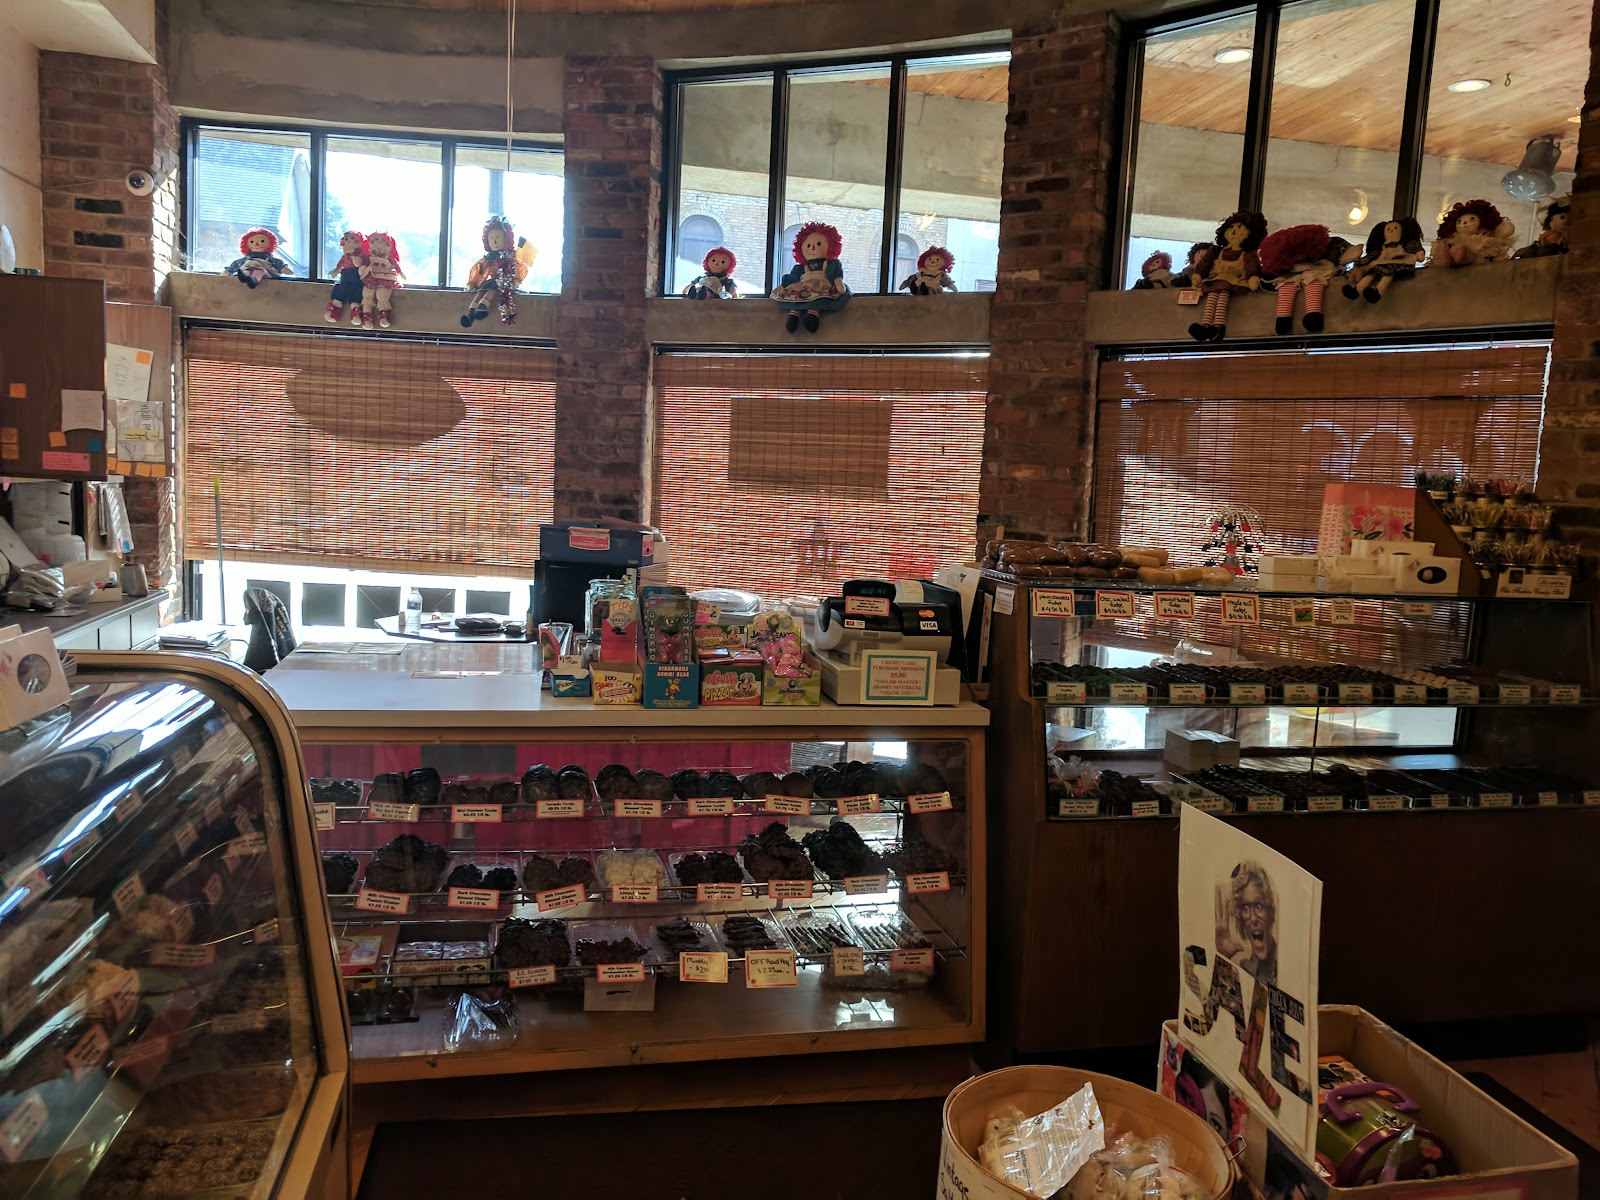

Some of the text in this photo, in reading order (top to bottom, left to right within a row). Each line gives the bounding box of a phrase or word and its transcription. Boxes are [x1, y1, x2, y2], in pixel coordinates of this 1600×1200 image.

[611, 601, 634, 613] TIPS
[1233, 606, 1247, 614] fudge
[682, 611, 691, 646] GUMMI
[704, 686, 731, 702] PIZZA
[554, 888, 576, 897] Chocolate
[544, 896, 561, 904] Almond
[686, 956, 710, 967] Muddy
[750, 958, 764, 966] OFF
[766, 958, 780, 966] Road
[1183, 944, 1313, 1120] SALE
